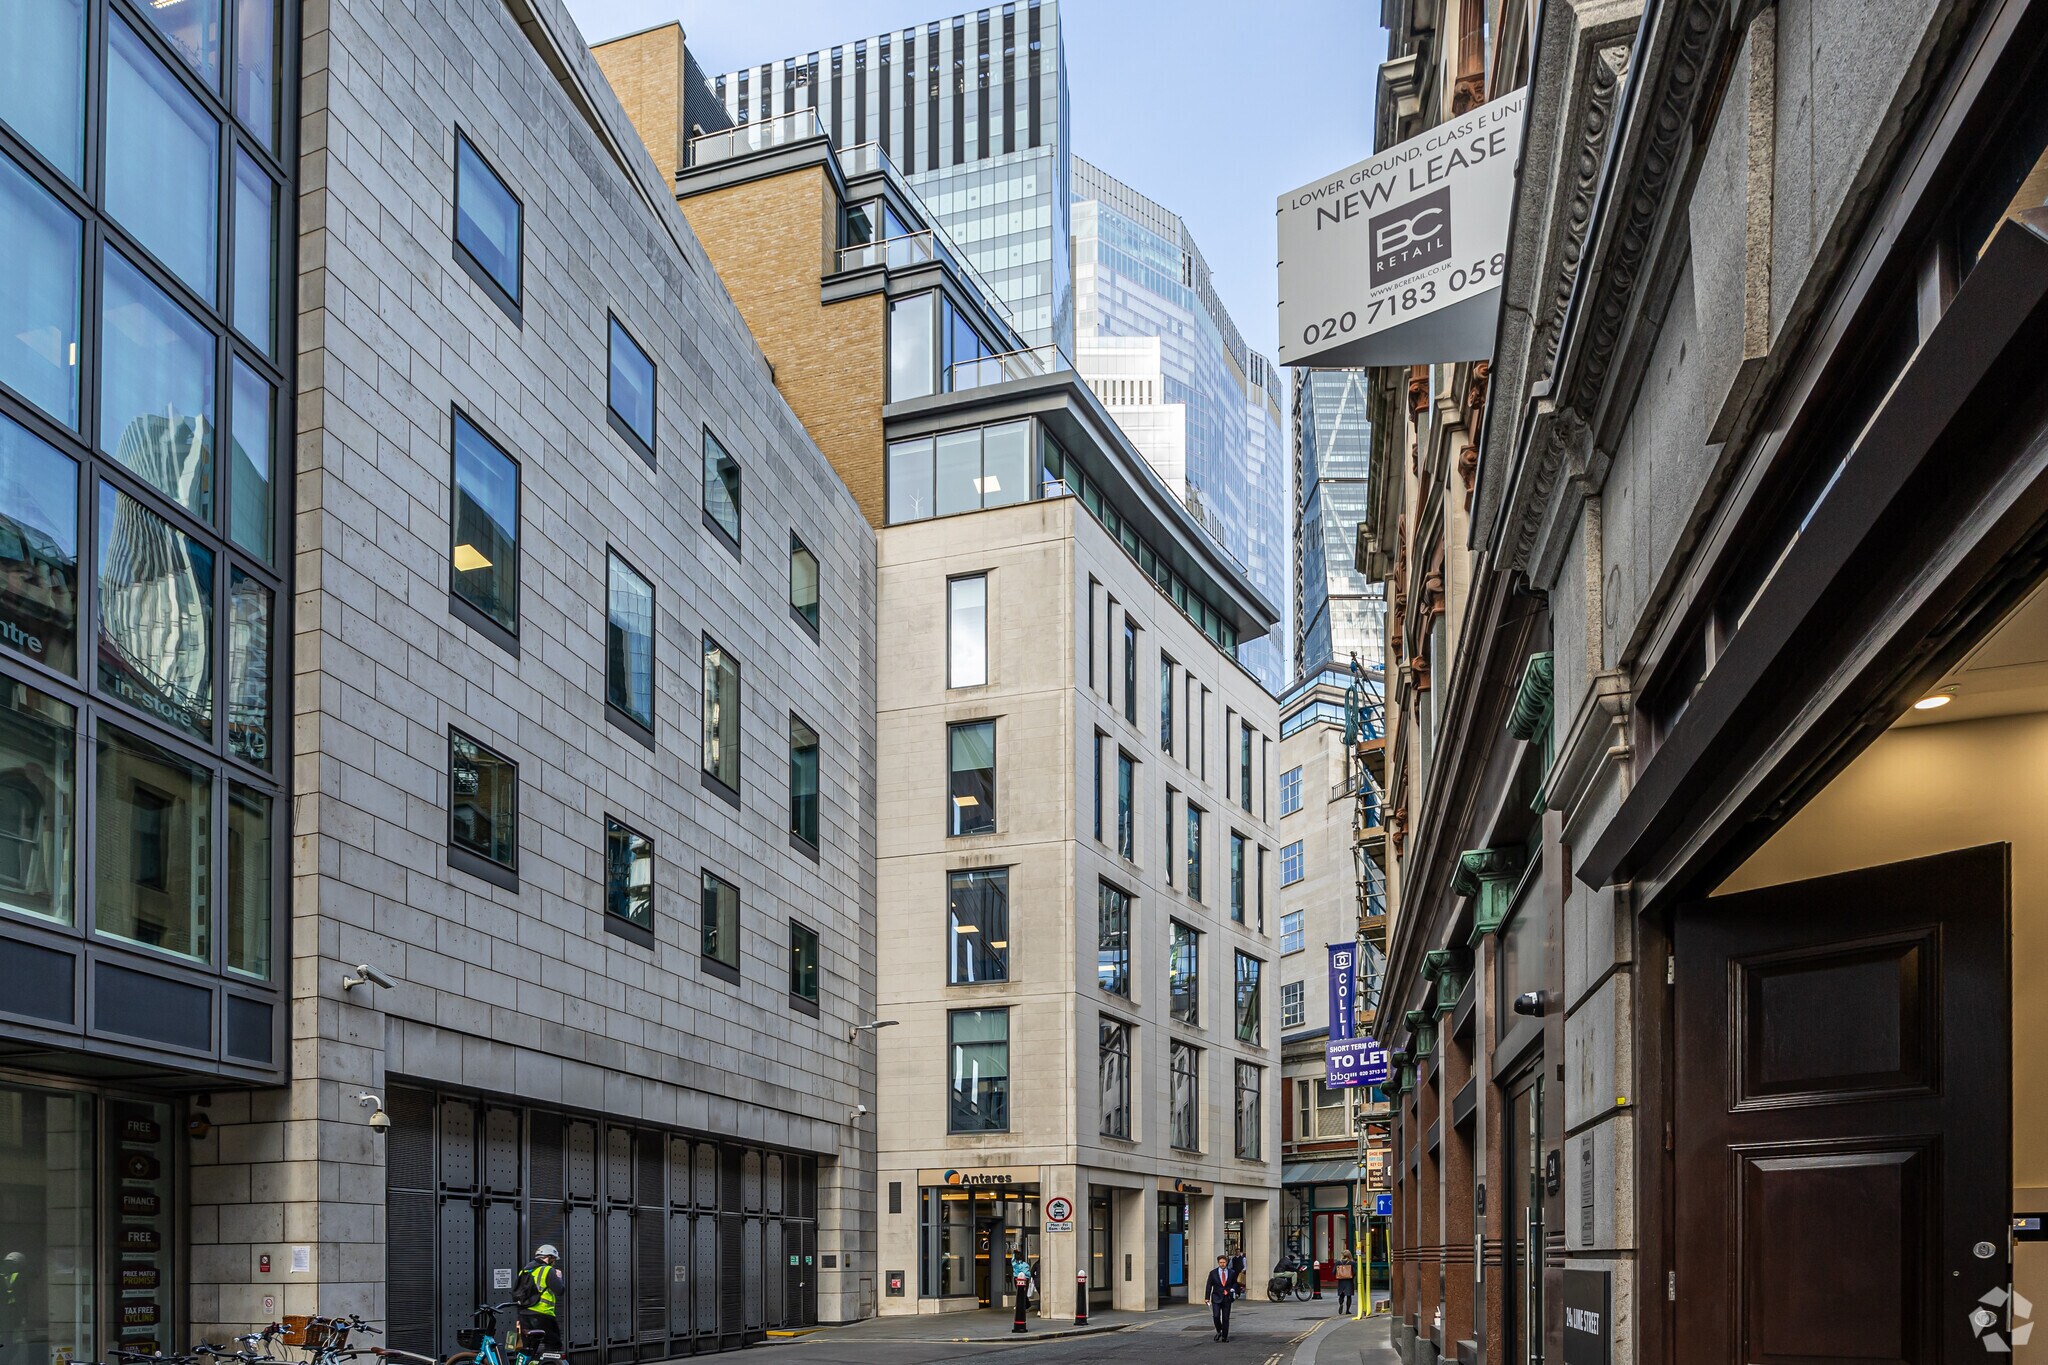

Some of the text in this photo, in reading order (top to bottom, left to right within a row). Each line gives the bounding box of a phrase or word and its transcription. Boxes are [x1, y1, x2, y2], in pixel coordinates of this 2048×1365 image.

[1292, 180, 1344, 210] LOWER
[1350, 147, 1422, 185] GROUND,
[1426, 121, 1473, 151] CLASS
[1479, 116, 1487, 129] E
[1317, 127, 1506, 230] NEW LEASE
[1376, 207, 1443, 258] BC
[1376, 238, 1444, 272] RETAIL
[1303, 312, 1357, 345] 020
[1367, 281, 1436, 325] 7183
[115, 674, 192, 727] in-store
[1339, 973, 1347, 1040] COLLI
[1330, 1044, 1349, 1053] SHORT
[1351, 1042, 1367, 1050] TERM
[1331, 1050, 1387, 1068] TO LET
[1330, 1072, 1350, 1082] bbg
[127, 1120, 151, 1132] FREE
[1549, 1158, 1556, 1177] 24
[961, 1173, 1012, 1184] Antares
[123, 1195, 155, 1205] FINANCE
[128, 1231, 151, 1242] FREE
[123, 1276, 155, 1285] PROMISE
[124, 1313, 154, 1323] CYCLING
[138, 1306, 154, 1314] FREE
[1574, 1308, 1584, 1331] LIME
[1584, 1310, 1600, 1336] STREET
